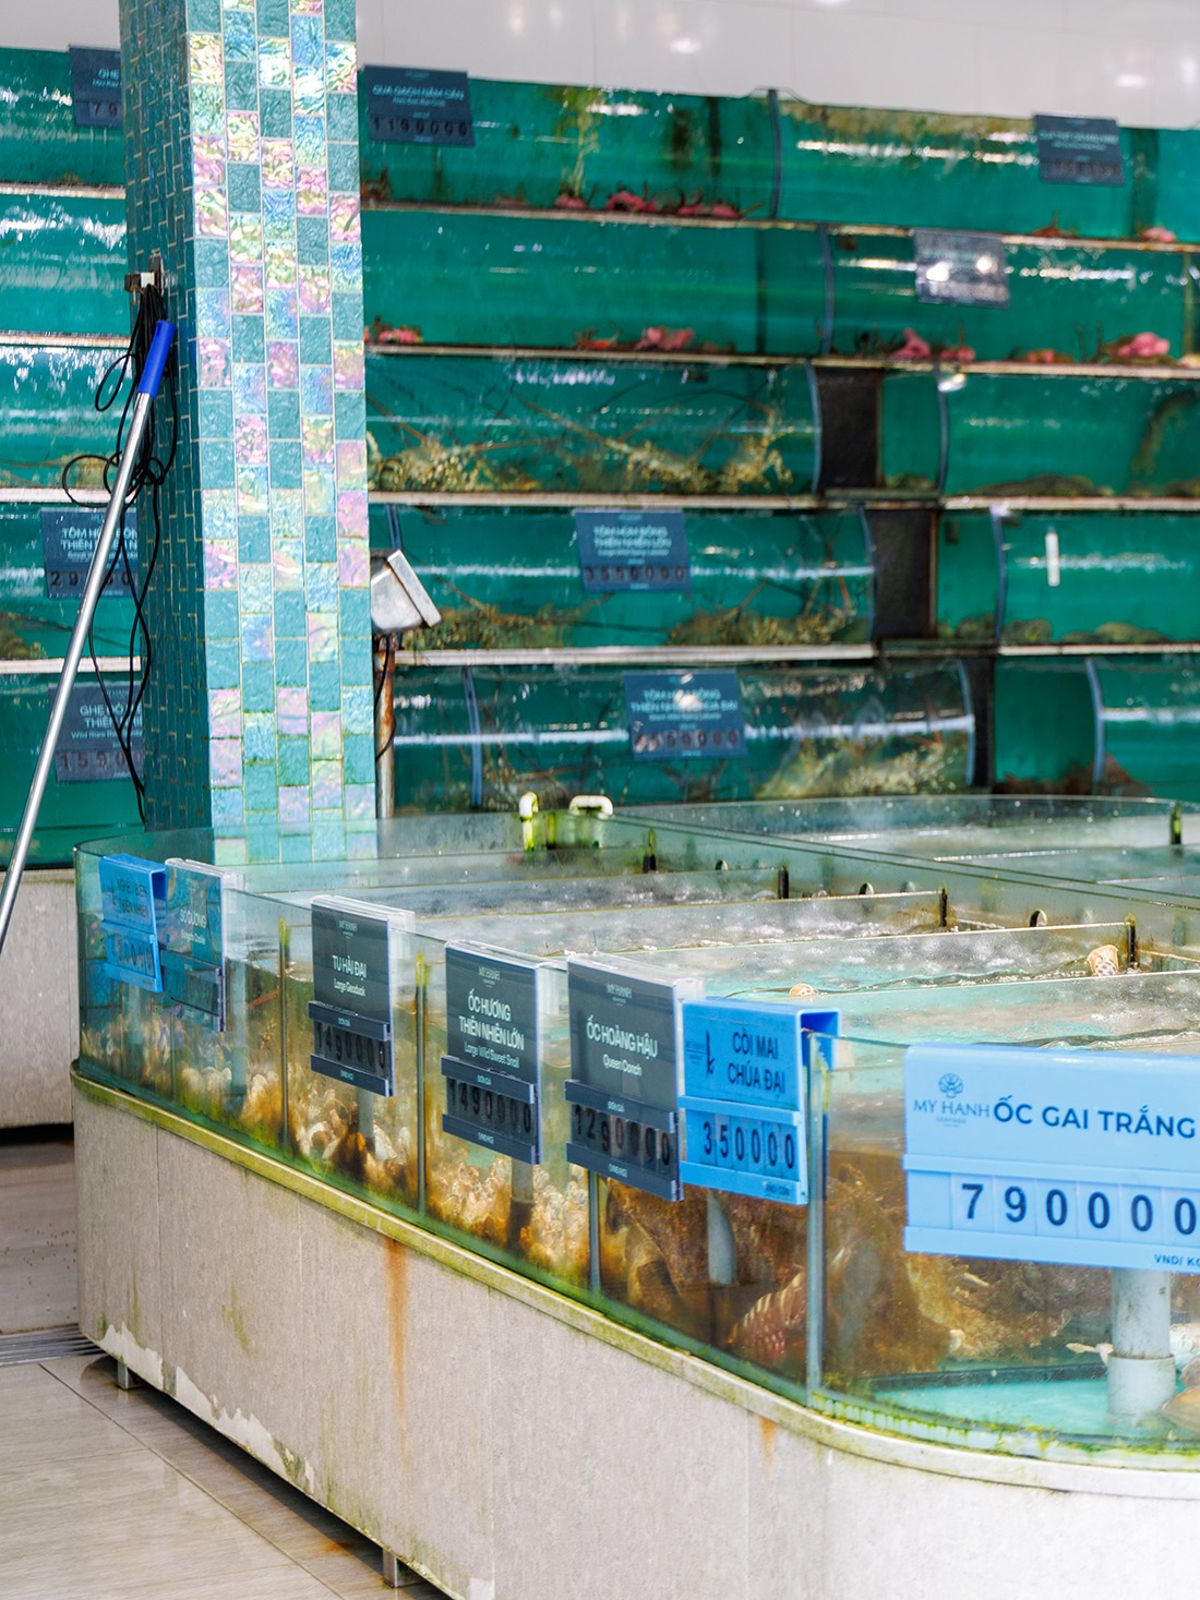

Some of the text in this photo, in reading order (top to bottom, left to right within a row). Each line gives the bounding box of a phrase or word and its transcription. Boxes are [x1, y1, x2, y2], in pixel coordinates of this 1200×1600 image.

[468, 988, 512, 1022] ỐC HƯƠNG
[459, 1015, 481, 1038] THIÊN
[507, 1027, 525, 1050] LỚN
[586, 1014, 658, 1060] ỐC HOÀNG HẬU
[756, 1034, 779, 1060] MAI
[602, 1053, 622, 1070] Queen
[728, 1060, 786, 1098] CHÚA ĐẠI
[575, 1103, 671, 1167] 1290000
[993, 1095, 1196, 1139] ỐC GAI TRẮNG
[703, 1120, 795, 1170] 350000
[961, 1183, 1197, 1236] 790000
